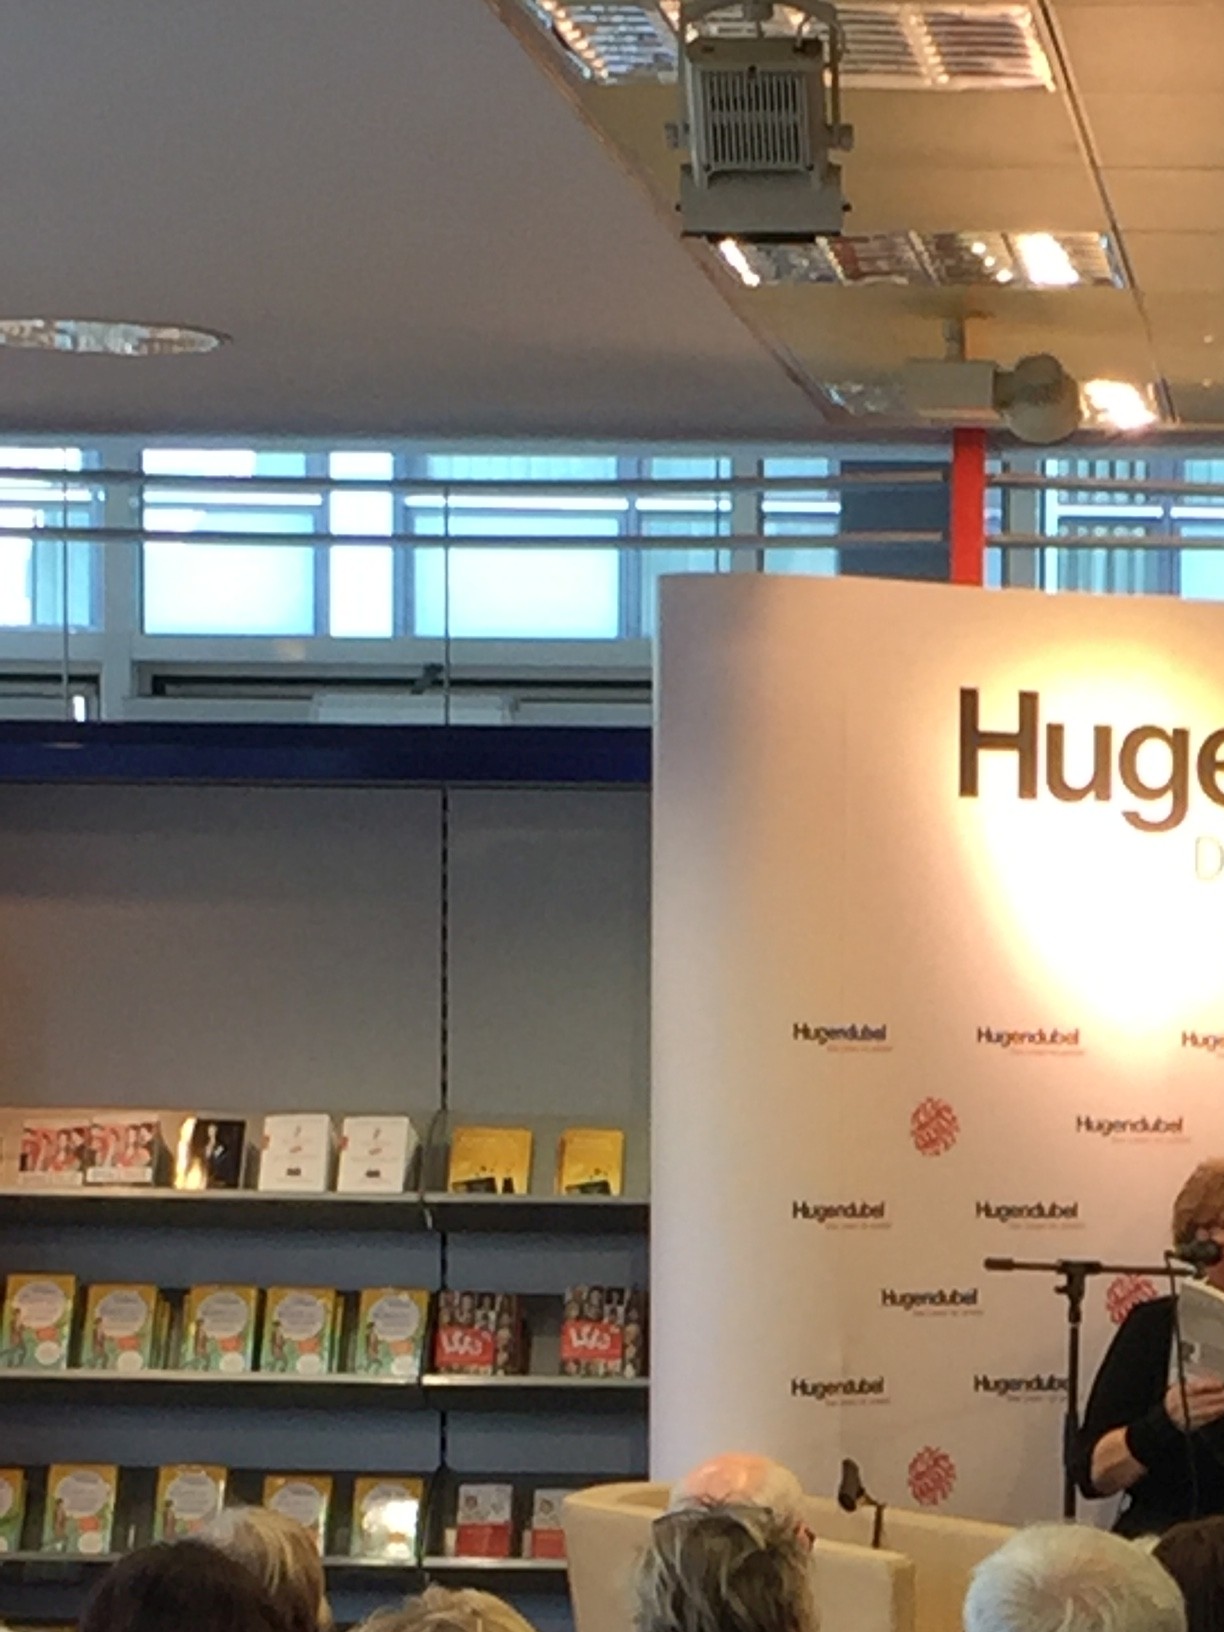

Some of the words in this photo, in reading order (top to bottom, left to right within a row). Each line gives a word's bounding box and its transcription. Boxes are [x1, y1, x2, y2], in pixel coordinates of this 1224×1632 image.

[793, 1023, 887, 1045] Hugendubel
[977, 1027, 1080, 1049] Hugendubel
[1076, 1115, 1184, 1137] Hugendubel
[792, 1200, 885, 1223] Hugendubel
[976, 1201, 1079, 1223] Hugendubel
[881, 1288, 979, 1310] Hugendubel
[791, 1376, 885, 1399] Hugendubel
[974, 1374, 1069, 1396] Hugendube
